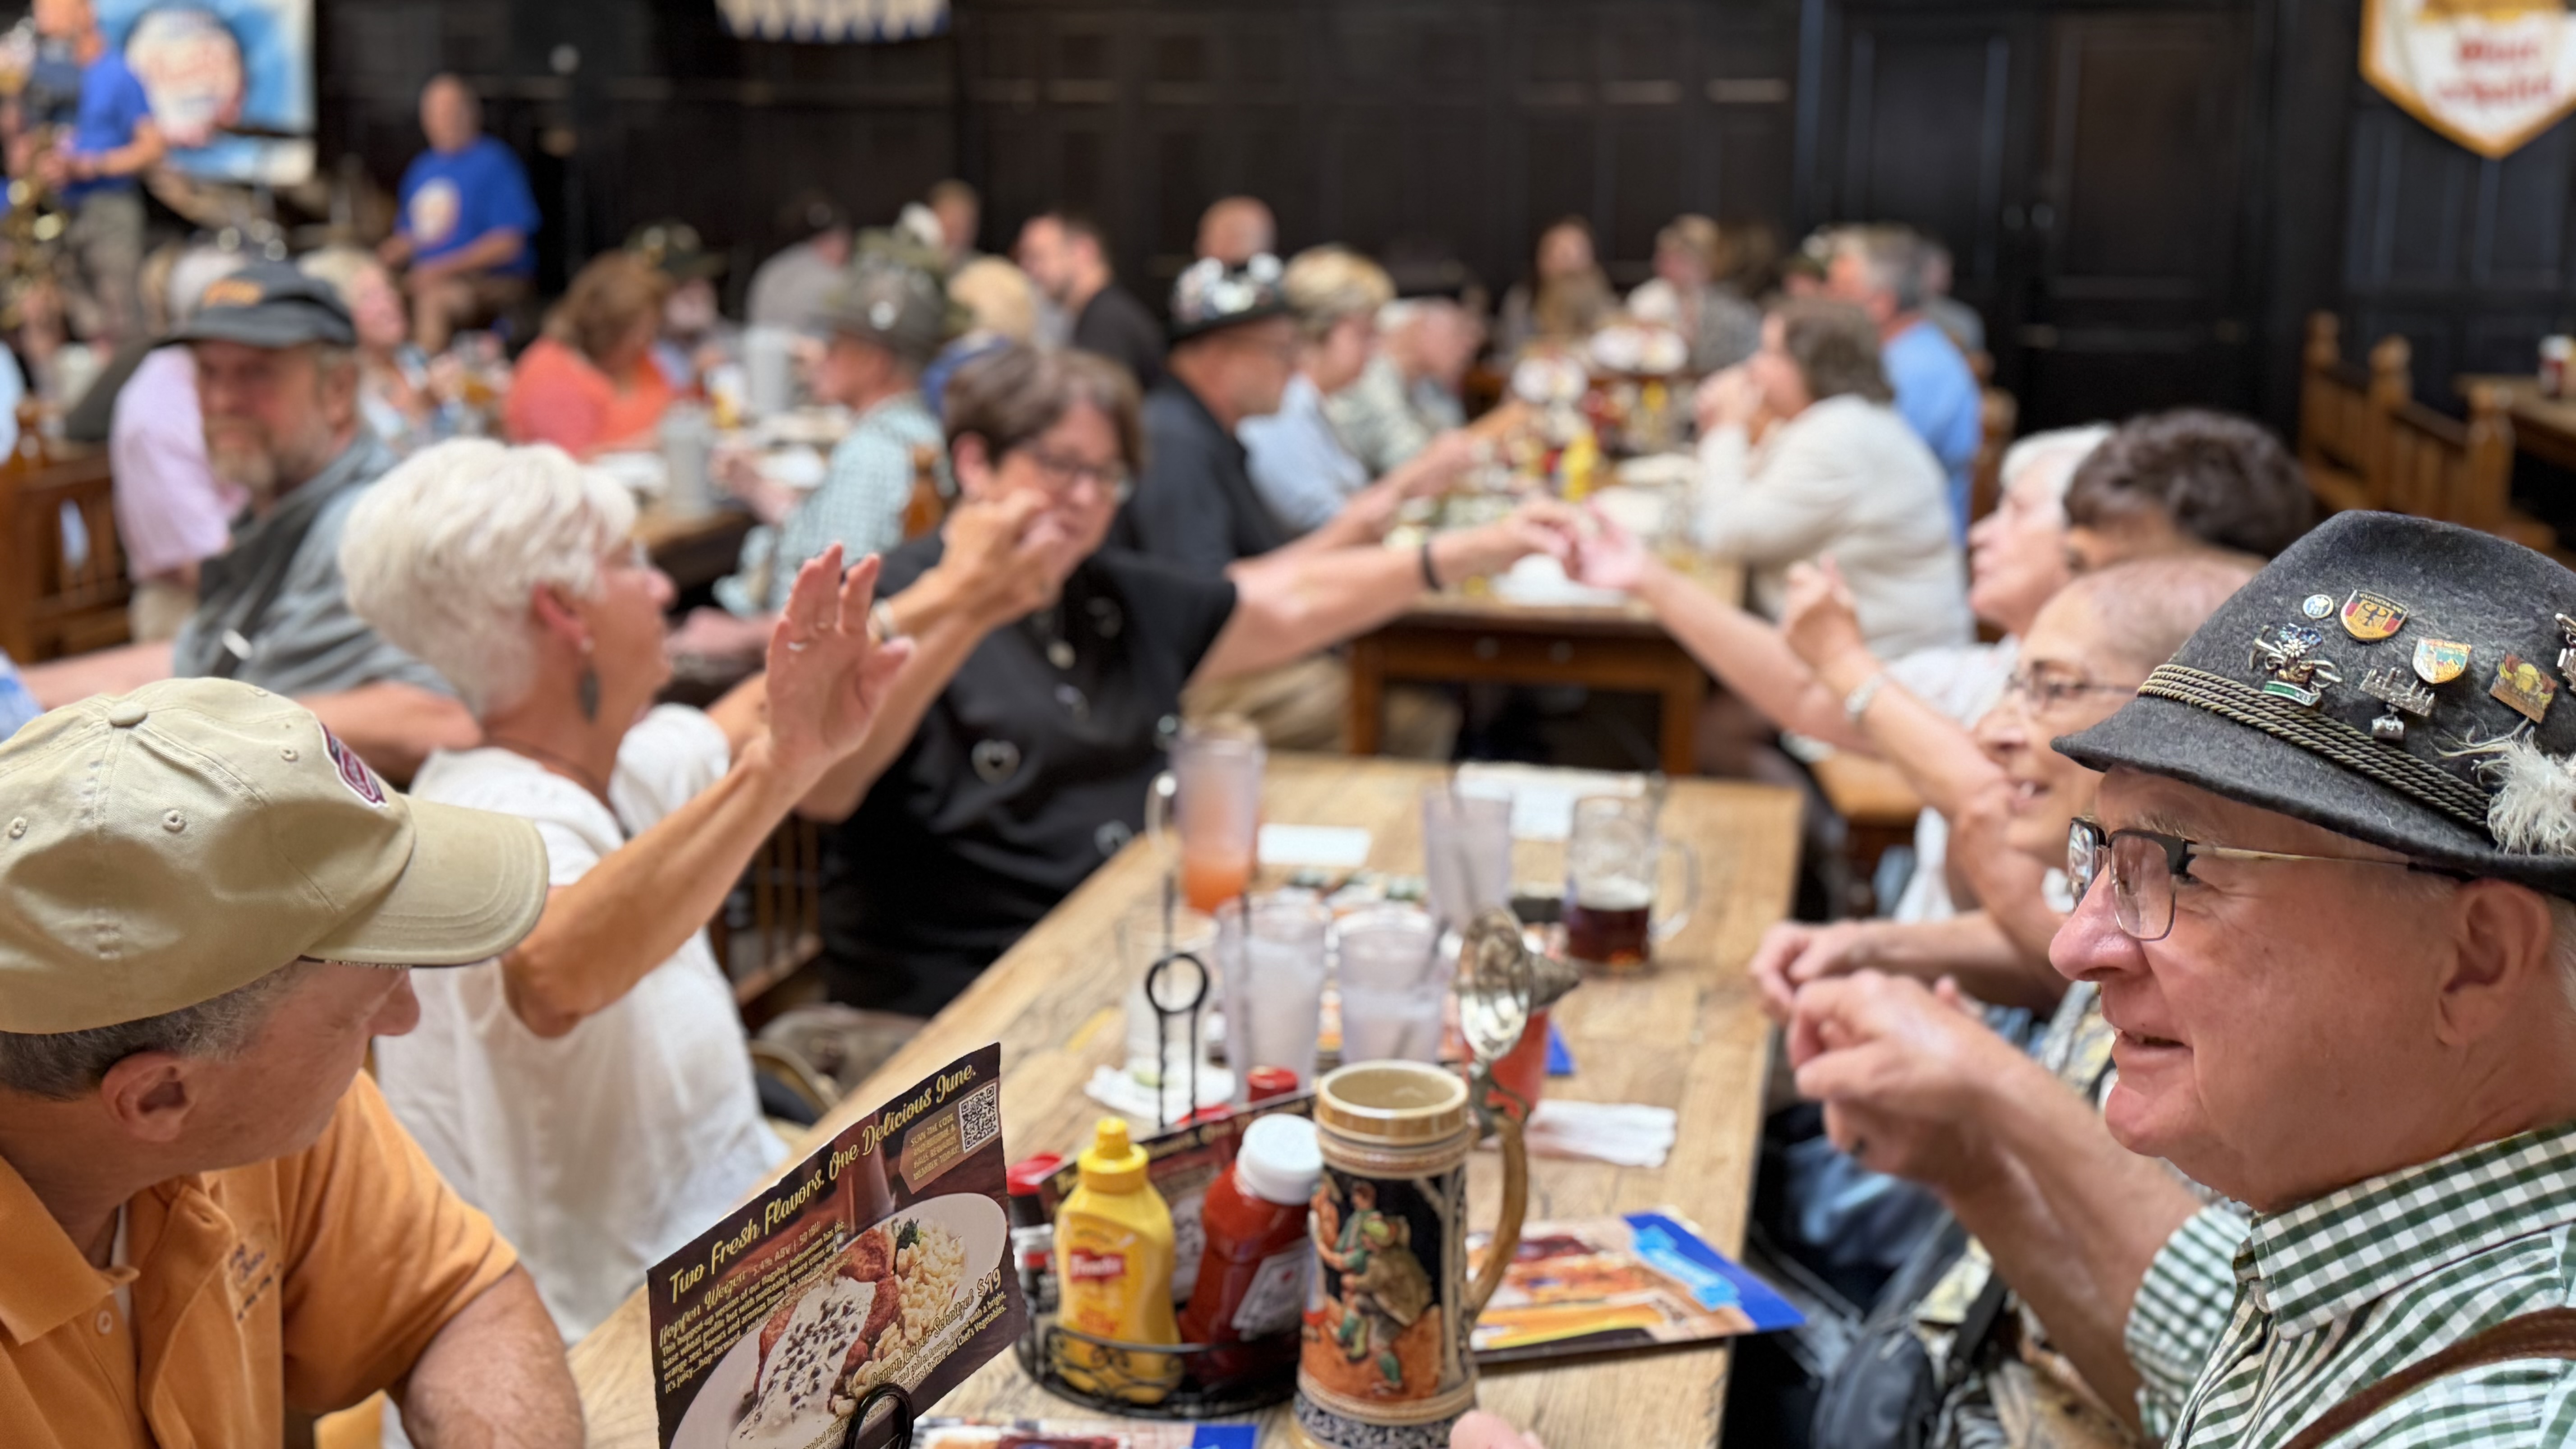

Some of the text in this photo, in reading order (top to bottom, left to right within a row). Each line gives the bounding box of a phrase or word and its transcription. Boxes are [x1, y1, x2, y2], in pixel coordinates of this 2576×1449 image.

[669, 1264, 705, 1303] Two
[711, 1219, 759, 1274] Fresh
[765, 1169, 825, 1235] Flavors.
[829, 1145, 859, 1180] One
[862, 1088, 932, 1155] Delicious
[936, 1065, 976, 1103] June.
[660, 1305, 700, 1347] Hopfen
[775, 1243, 792, 1261] ABV
[662, 1352, 679, 1369] base
[739, 1297, 755, 1313] with
[870, 1357, 902, 1389] Lemon
[977, 1267, 1001, 1297] $19
[974, 1304, 1007, 1332] Vegetables.
